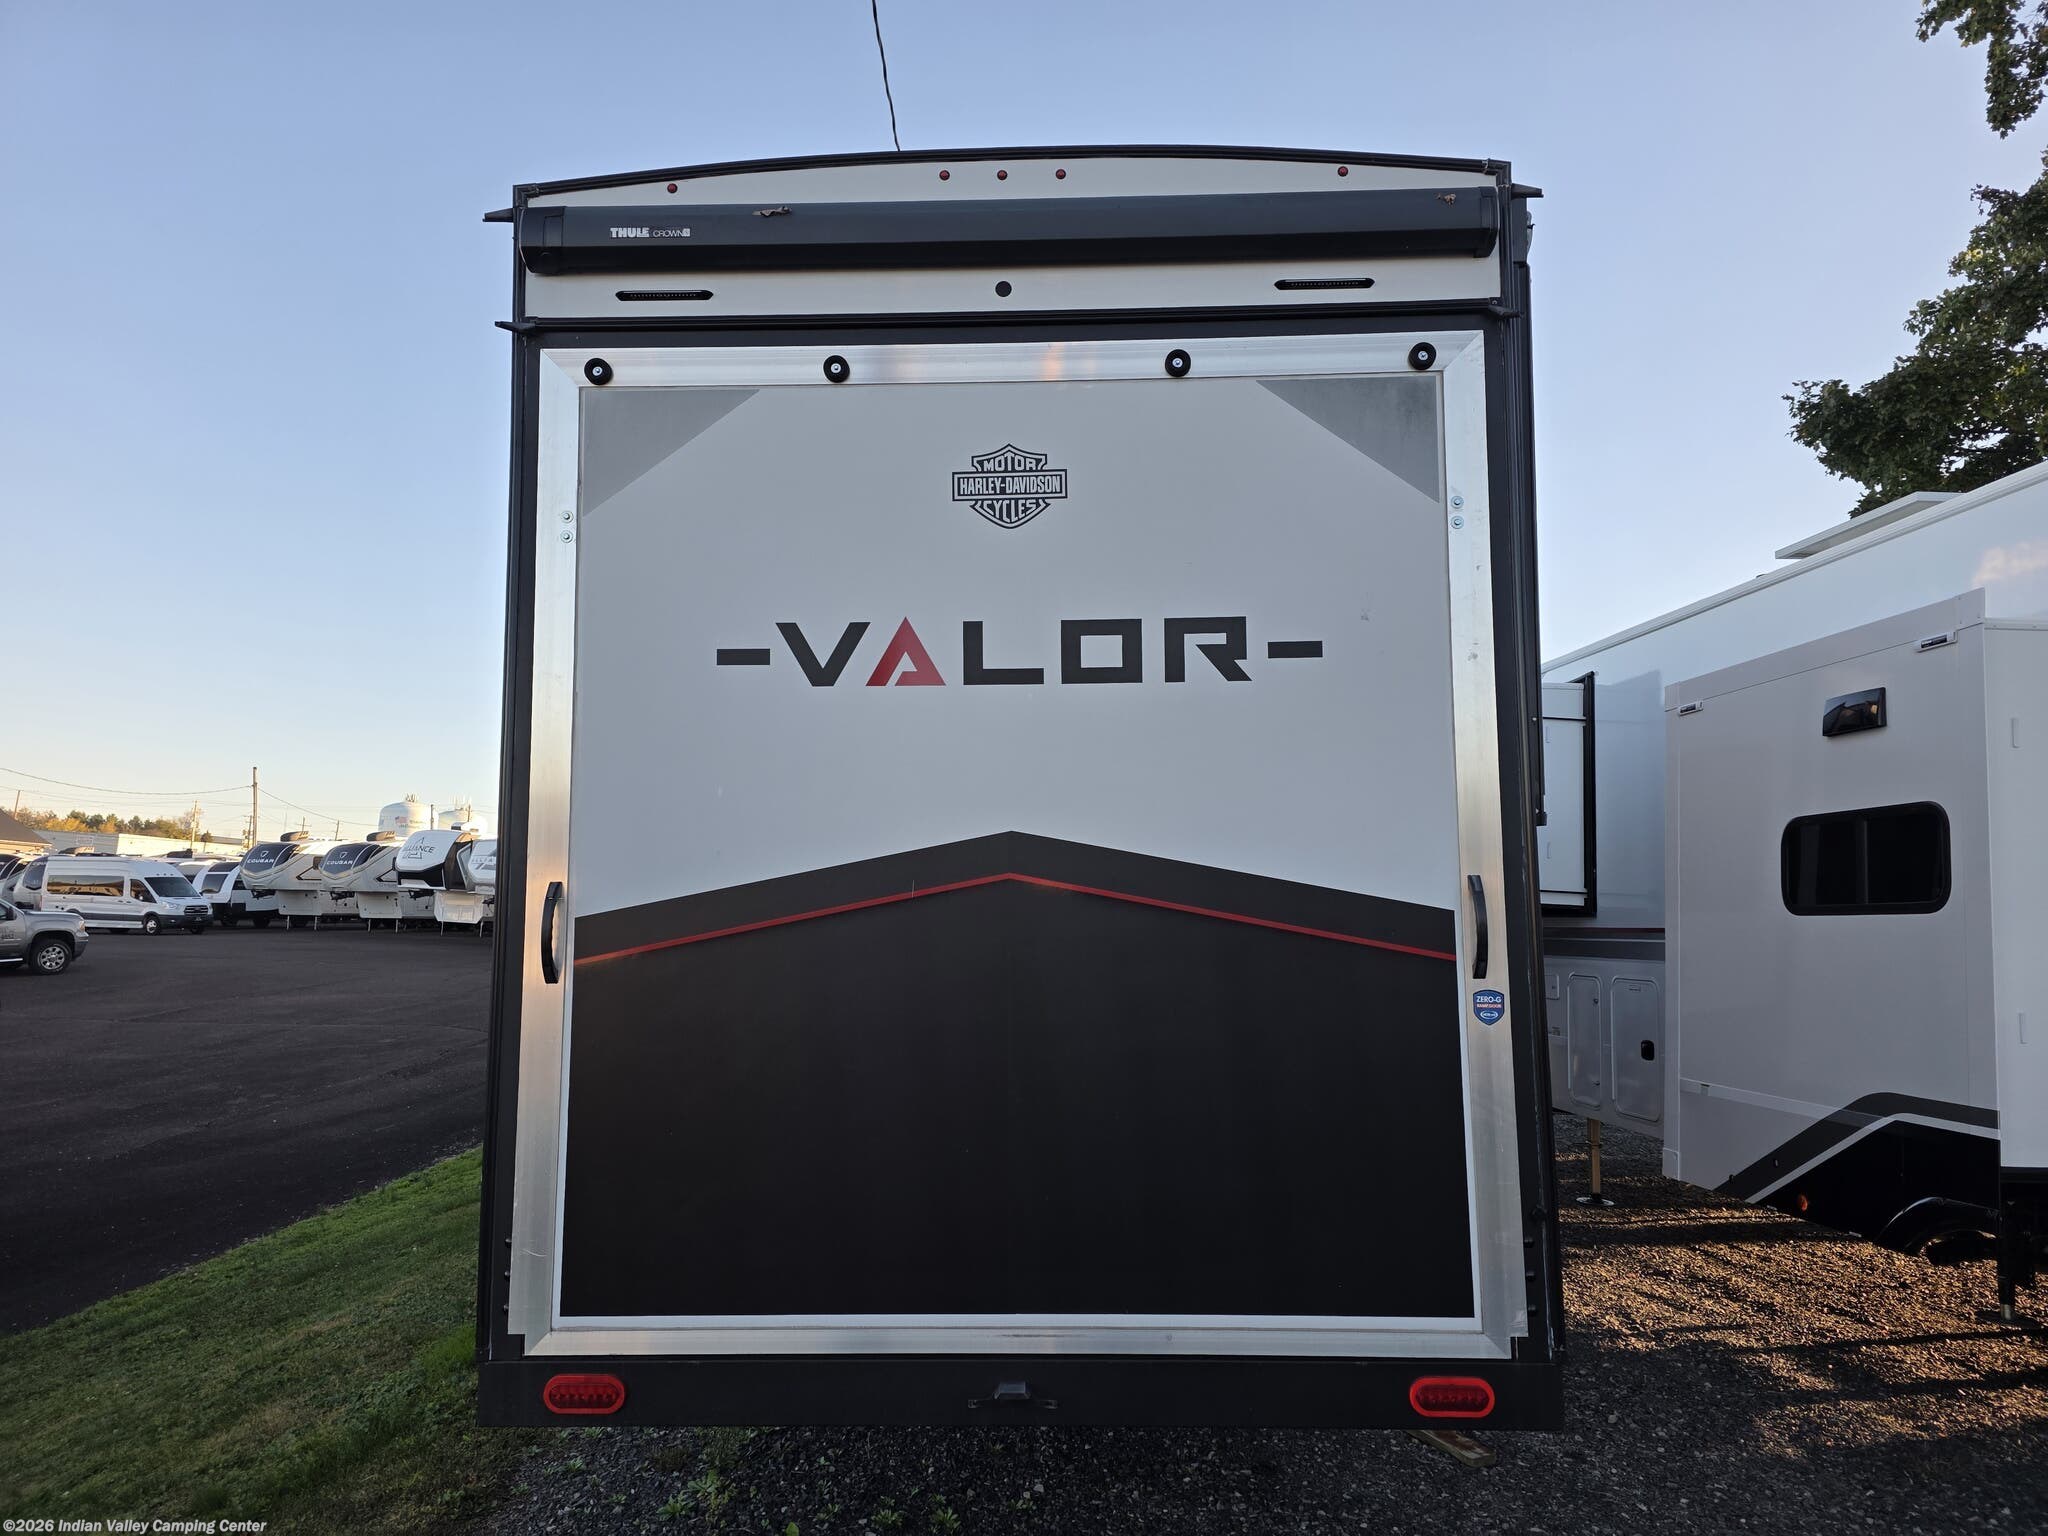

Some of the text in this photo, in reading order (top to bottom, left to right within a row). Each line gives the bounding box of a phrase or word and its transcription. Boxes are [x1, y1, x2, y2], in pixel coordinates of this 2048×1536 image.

[610, 227, 650, 238] THULE
[983, 451, 1037, 472] MOTOR
[960, 475, 1061, 495] HARLEY-DAVIDSON
[983, 499, 1037, 523] CYCLES
[1476, 995, 1502, 1003] ZERO-G
